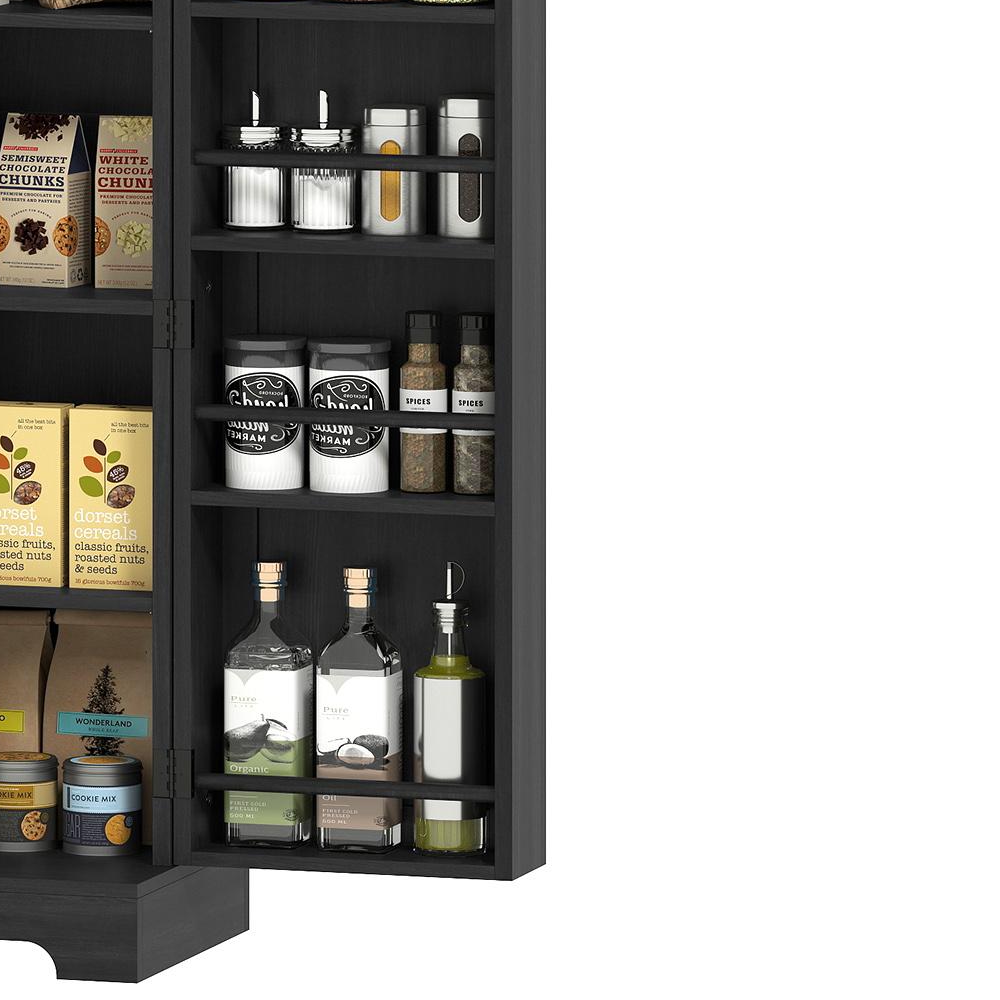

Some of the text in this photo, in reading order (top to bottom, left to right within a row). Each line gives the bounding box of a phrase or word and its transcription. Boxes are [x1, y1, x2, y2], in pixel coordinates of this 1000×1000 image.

[1, 154, 67, 164] SEMISWEET
[100, 156, 149, 165] WHITE
[0, 164, 66, 174] CHOCOLATE
[98, 177, 153, 188] CHUN
[74, 508, 130, 524] dorset
[74, 527, 137, 540] cereals
[22, 539, 56, 551] fruits,
[74, 542, 149, 554] classic fruits,
[26, 552, 52, 560] nuts
[75, 554, 145, 564] roasted nuts
[74, 564, 117, 574] & seeds
[75, 718, 132, 728] WONDERLAND
[230, 764, 269, 774] Organic
